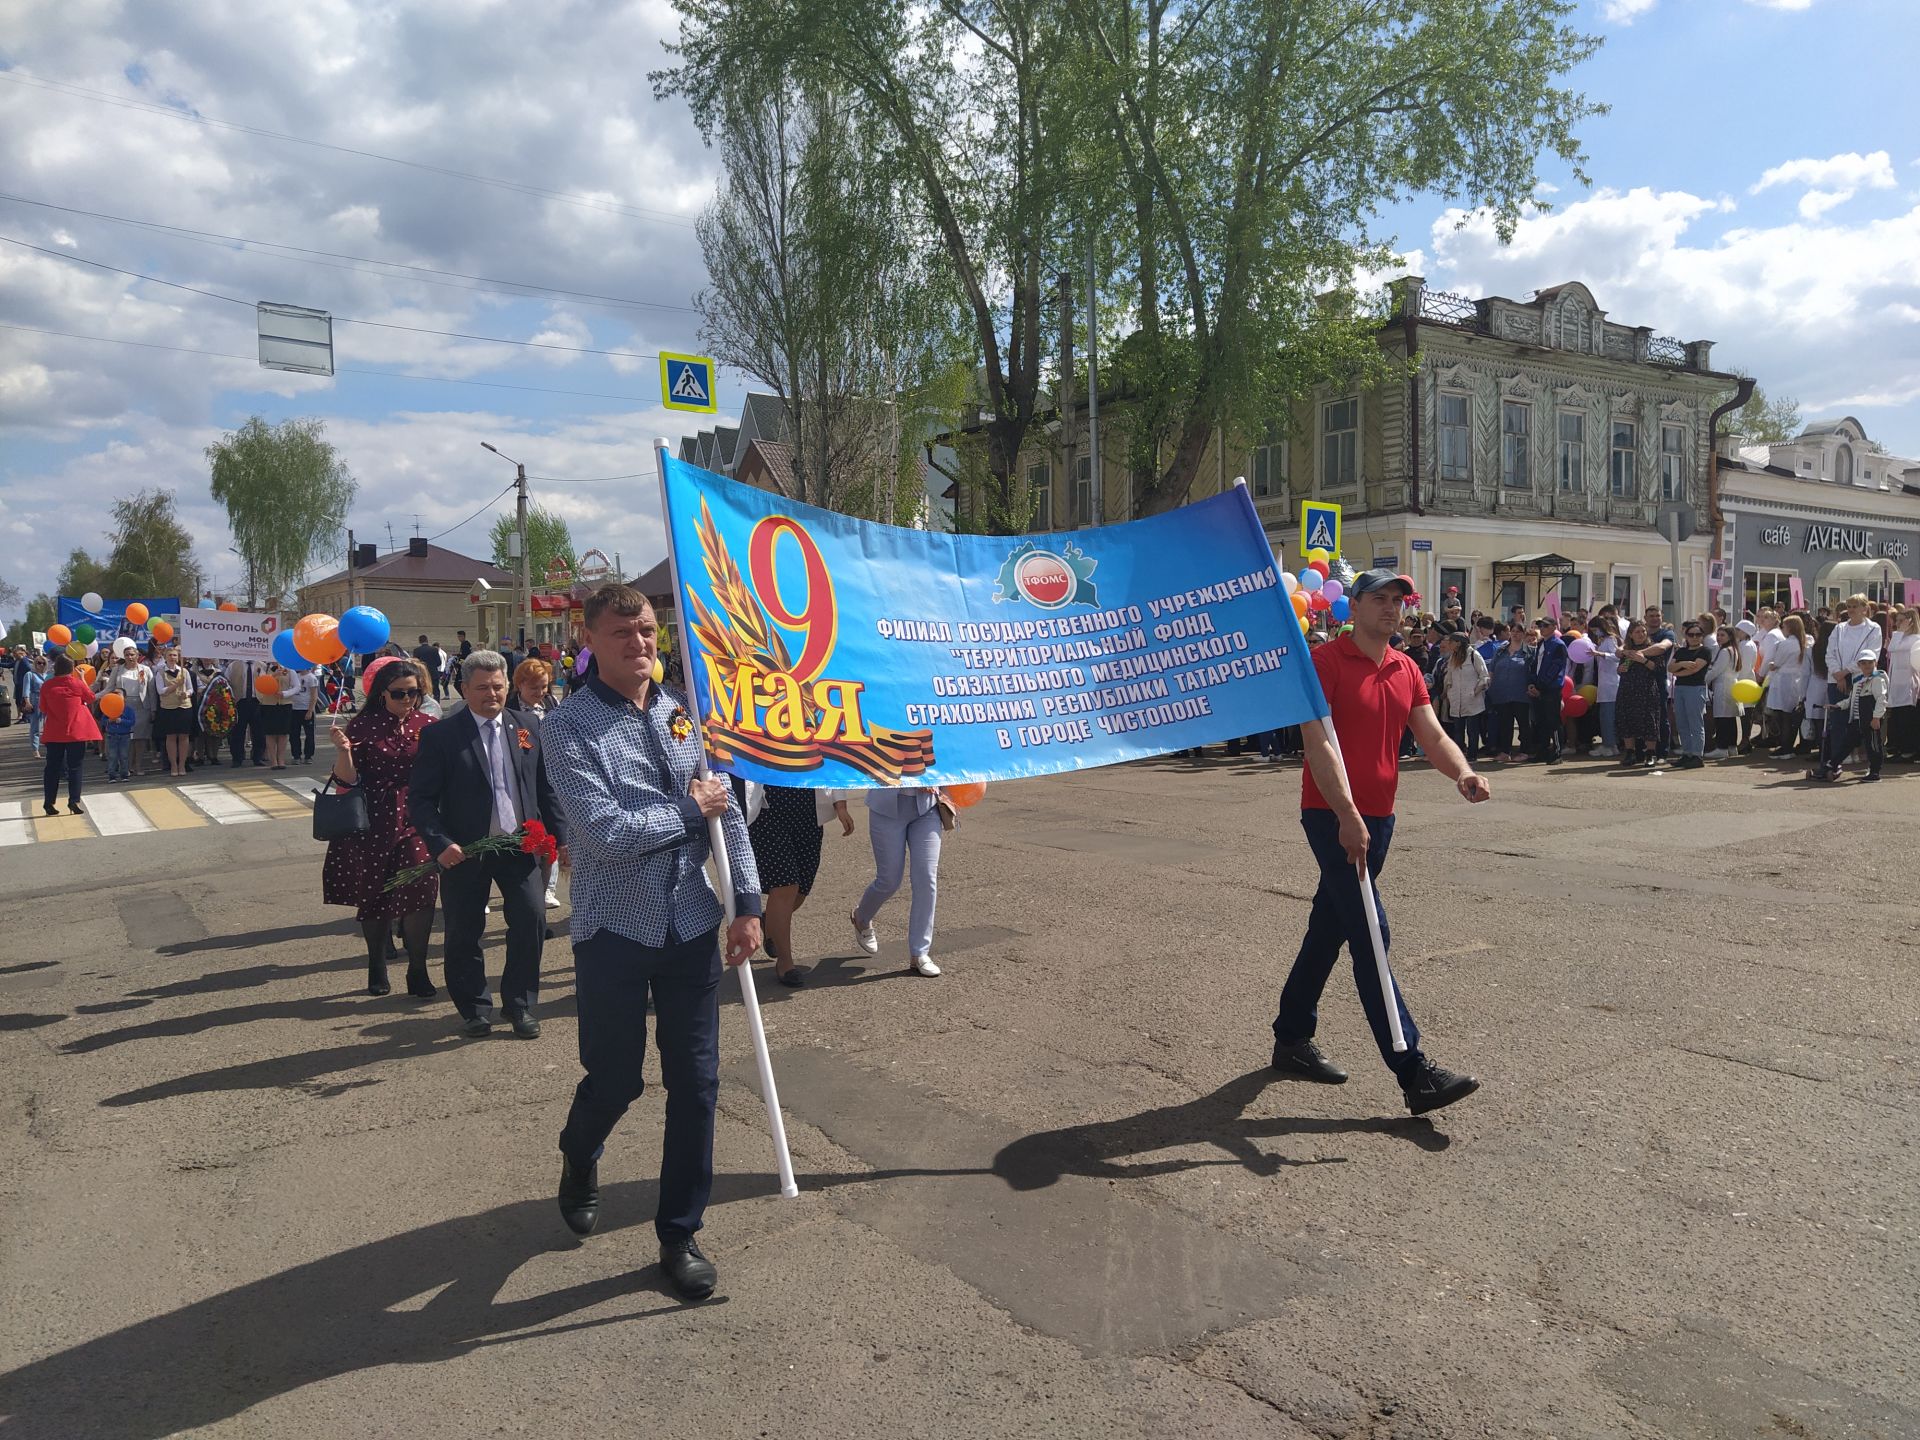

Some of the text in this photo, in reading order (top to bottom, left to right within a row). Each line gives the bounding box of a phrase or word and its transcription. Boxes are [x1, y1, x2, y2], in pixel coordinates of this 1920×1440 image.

[1763, 524, 1909, 560] café AVENUE кафе
[749, 515, 838, 688] 9
[876, 565, 1277, 644] ФИЛИАЛ ГОСУДАРСТВЕННОГО УЧРЕЖДЕНИЯ
[1023, 574, 1068, 586] ТФОМС
[185, 619, 259, 633] Чистополь
[213, 640, 269, 649] документы
[951, 612, 1216, 669] "ТЕРРИТОРИАЛЬНЫЙ ФОНД
[905, 646, 1290, 726] СТРАХОВАНИЯ РЕСПУБЛИКИ ТАТАРСТАН"
[932, 630, 1249, 698] ОБЯЗАТЕЛЬНОГО МЕДИЦИНСКОГО
[700, 650, 874, 743] Мая
[996, 695, 1213, 749] В ГОРОДЕ ЧИСТОПОЛЕ
